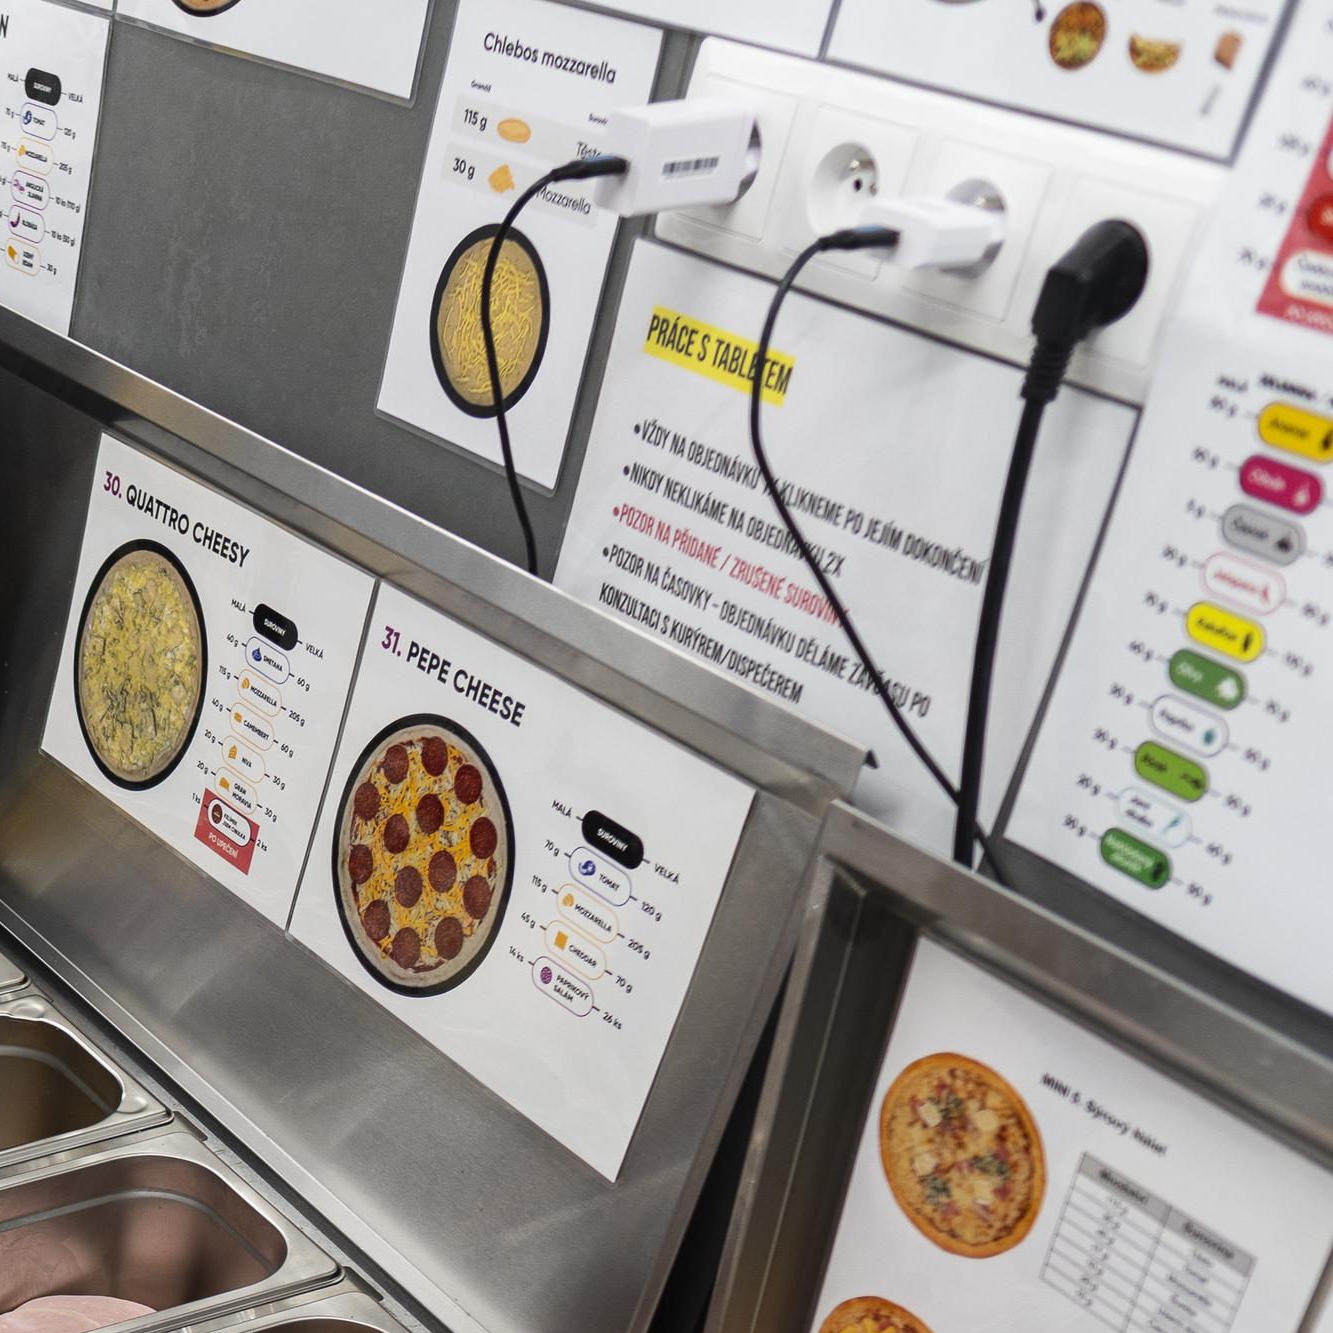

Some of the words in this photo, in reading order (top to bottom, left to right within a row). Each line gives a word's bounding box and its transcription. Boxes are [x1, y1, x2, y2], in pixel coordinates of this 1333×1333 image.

[484, 32, 538, 63] Chlebos
[540, 50, 617, 84] mozzarella
[463, 108, 478, 125] 115
[480, 115, 488, 131] g
[452, 157, 466, 173] 30
[467, 164, 475, 180] g
[646, 314, 699, 357] PRÁCE
[697, 333, 710, 362] S
[103, 471, 122, 499] 30.
[126, 484, 190, 535] QUATTRO
[192, 521, 250, 568] CHEESY
[630, 462, 664, 494] NIKDY
[663, 477, 729, 525] NEKLIKÁME
[727, 507, 745, 534] NA
[823, 550, 846, 579] 2X
[642, 417, 670, 449] VŽDY
[669, 433, 686, 458] NA
[687, 440, 762, 490] OBJEDNÁVKU
[842, 508, 864, 535] PO
[862, 520, 903, 551] JEJÍM
[902, 532, 989, 586] DOKONČENÍ
[619, 503, 655, 535] POZOR
[654, 521, 670, 545] NA
[671, 527, 723, 570] PŘIDANÉ
[729, 556, 787, 600] ZRUŠENÉ
[231, 598, 247, 613] MALÁ
[263, 618, 287, 637] SUROVINY
[305, 643, 324, 659] VELKÁ
[599, 582, 663, 631] KONZULTACI
[660, 615, 670, 635] S
[609, 544, 644, 577] POZOR
[643, 561, 660, 586] NA
[661, 565, 713, 611] ČASOVKY
[719, 599, 798, 653] OBJEDNÁVKU
[795, 632, 850, 680] DĚLÁME
[908, 690, 932, 717] PO
[263, 655, 283, 672] SMETANA
[381, 625, 401, 657] 31.
[406, 640, 452, 685] PEPE
[453, 668, 526, 728] CHEESE
[219, 665, 227, 676] 115
[249, 685, 277, 708] MOZZARELLA
[289, 710, 300, 722] 205
[243, 719, 270, 742] CAMEMBERT
[242, 756, 253, 769] NIVA
[273, 775, 281, 786] 30
[231, 791, 252, 810] MORAVIA
[265, 806, 273, 819] 30
[209, 832, 217, 844] PO
[216, 836, 239, 860] UPEČENÍ
[551, 799, 572, 818] MALÁ
[597, 827, 629, 852] SUROVINY
[654, 863, 680, 885] VELKÁ
[545, 839, 554, 852] 70
[599, 873, 621, 892] TOMAT
[641, 902, 655, 916] 120
[655, 911, 663, 922] g
[531, 874, 542, 888] 115
[575, 903, 613, 933] MOZZARELLA
[627, 939, 643, 954] 205
[643, 950, 651, 960] g
[521, 912, 530, 924] 45
[568, 944, 597, 968] CHEDDAR
[615, 975, 626, 987] 70
[625, 983, 633, 994] g
[515, 951, 525, 963] ks
[556, 974, 589, 1001] PAPRIKOVÝ
[603, 1012, 613, 1024] 26
[613, 1017, 623, 1030] ks
[553, 984, 574, 1003] SALÁM
